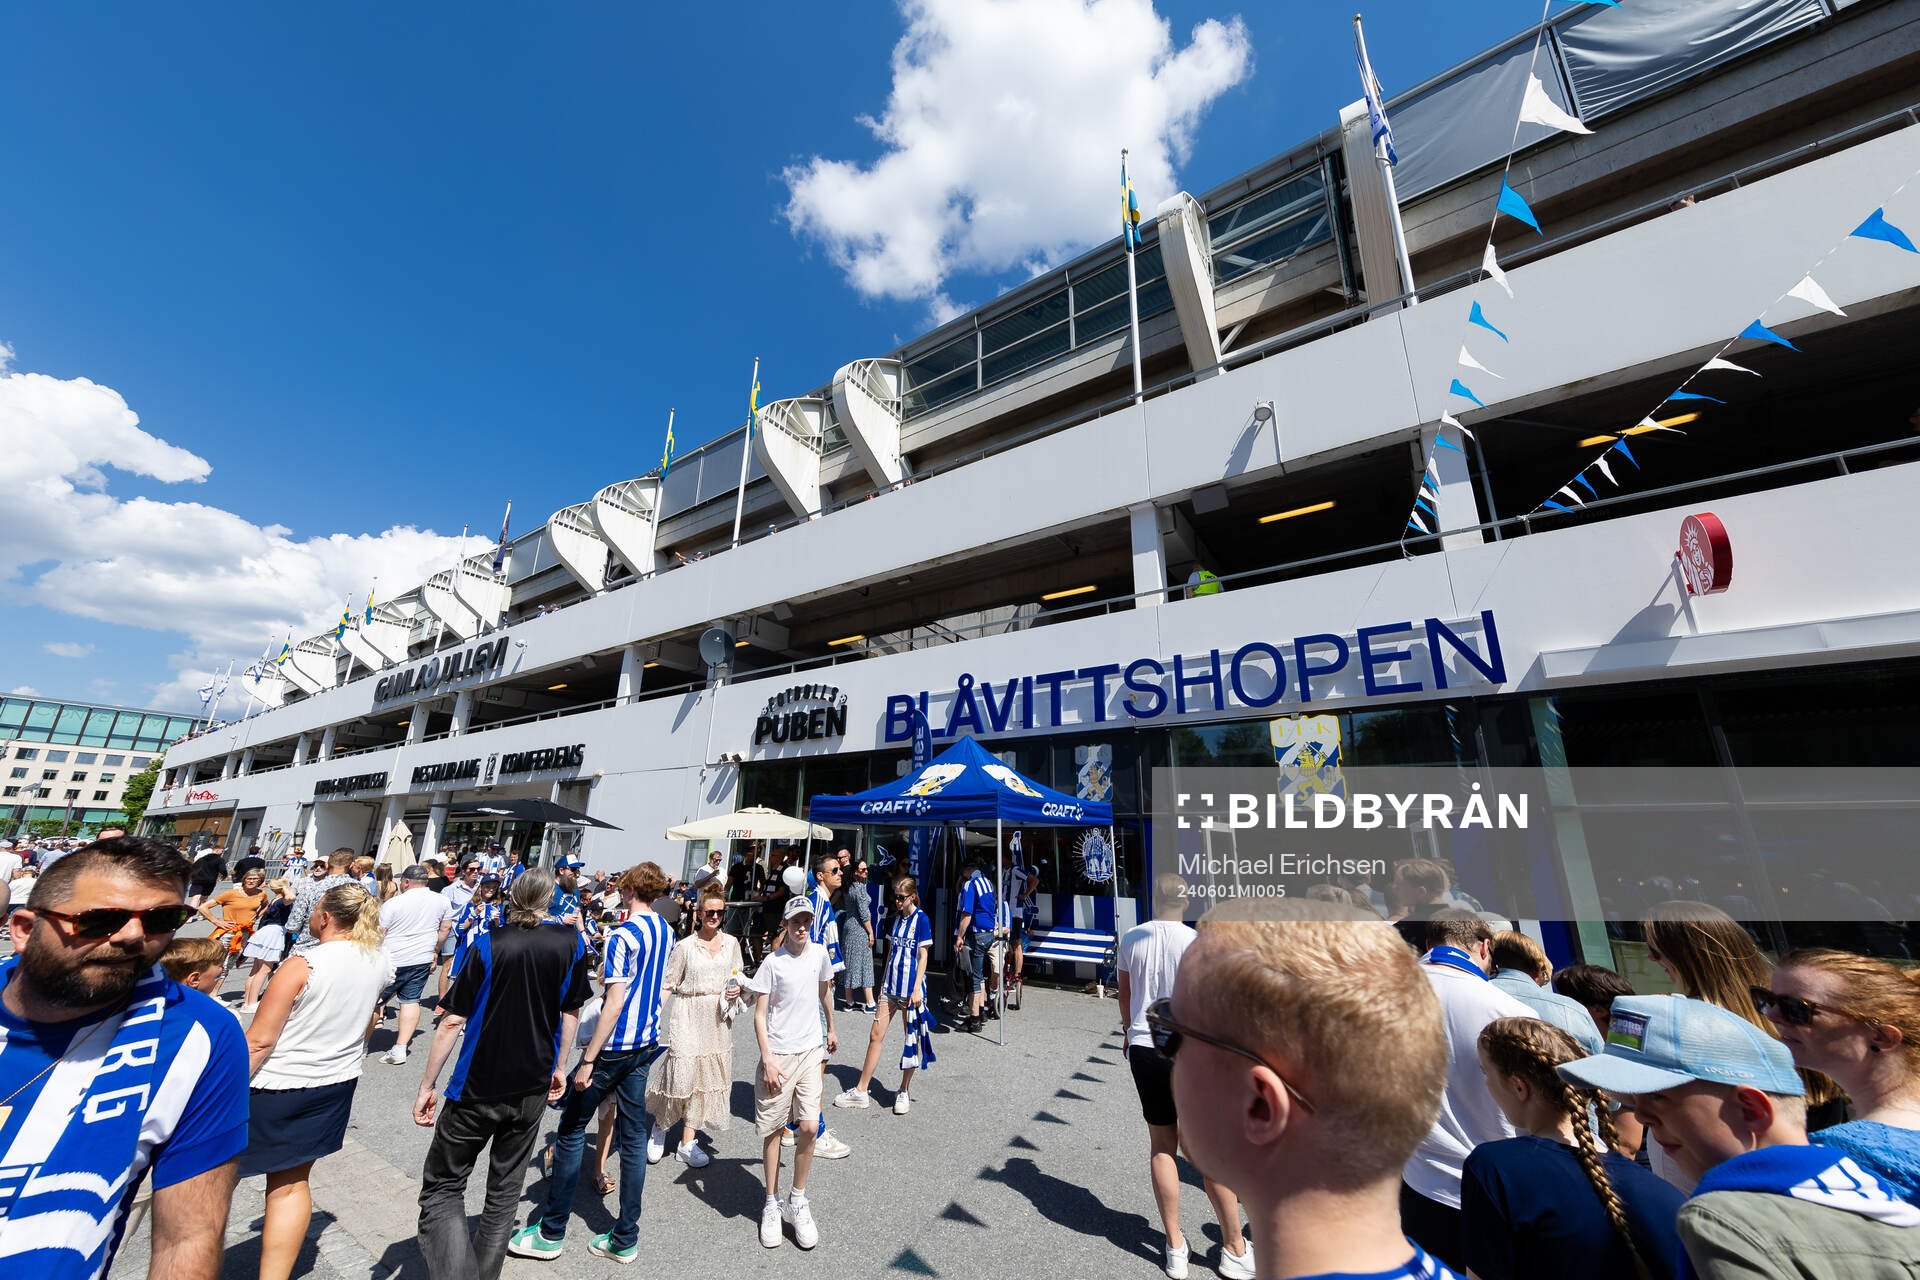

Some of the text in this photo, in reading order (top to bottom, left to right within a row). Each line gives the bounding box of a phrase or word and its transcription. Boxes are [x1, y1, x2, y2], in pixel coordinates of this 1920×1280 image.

[374, 635, 510, 703] GAMLA ULLEVI
[884, 609, 1508, 743] BLÅVITTSHOPEN
[767, 683, 839, 712] FOTBOLLS
[754, 704, 848, 746] PUBEN
[411, 758, 482, 784] RESTAURANG
[500, 743, 586, 775] KONFERENS
[861, 800, 916, 815] CRAFT
[1041, 802, 1076, 819] CRAFT
[726, 829, 753, 839] FAT21
